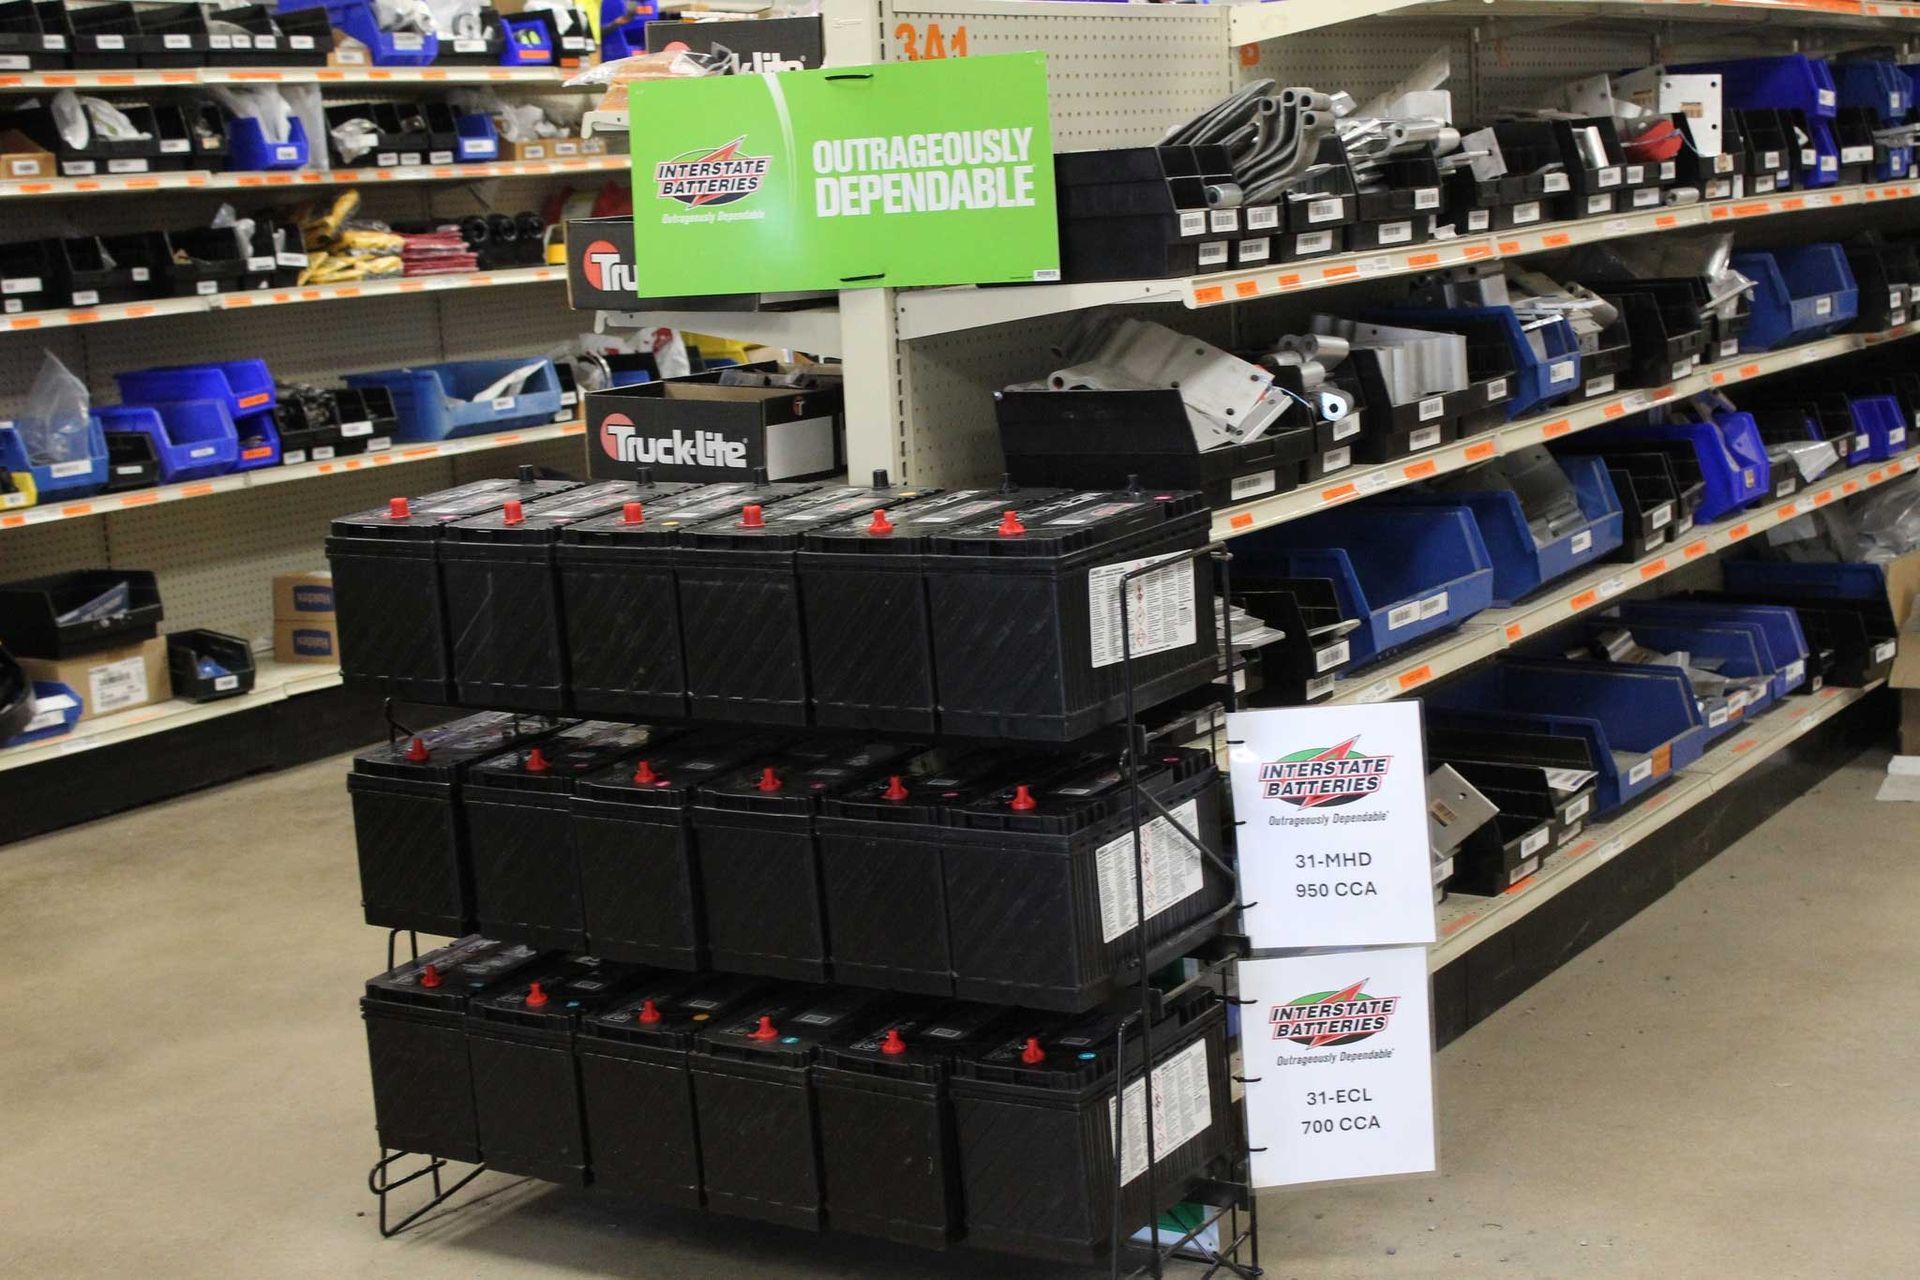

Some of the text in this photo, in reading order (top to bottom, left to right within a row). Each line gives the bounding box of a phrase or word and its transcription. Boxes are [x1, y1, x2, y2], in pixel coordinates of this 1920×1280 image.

[812, 127, 1034, 175] OUTRAGEOUSLY
[658, 159, 766, 179] INTERSTATE
[662, 176, 759, 195] BATTERIES
[815, 165, 1036, 218] DEPENDABLE
[1262, 758, 1387, 779] INTERSTATE
[1267, 776, 1378, 797] BATTERIES
[1268, 811, 1387, 828] Outrageously Dependable
[1295, 851, 1373, 868] 31-MHD
[1296, 881, 1378, 898] 950 CCA
[1272, 1000, 1394, 1021] INTERSTATE
[1276, 1017, 1385, 1037] BATTERIES
[1276, 1049, 1393, 1067] Outrageously Dependable
[1306, 1088, 1373, 1106] 31-ECL
[1301, 1115, 1381, 1135] 700 CCA
